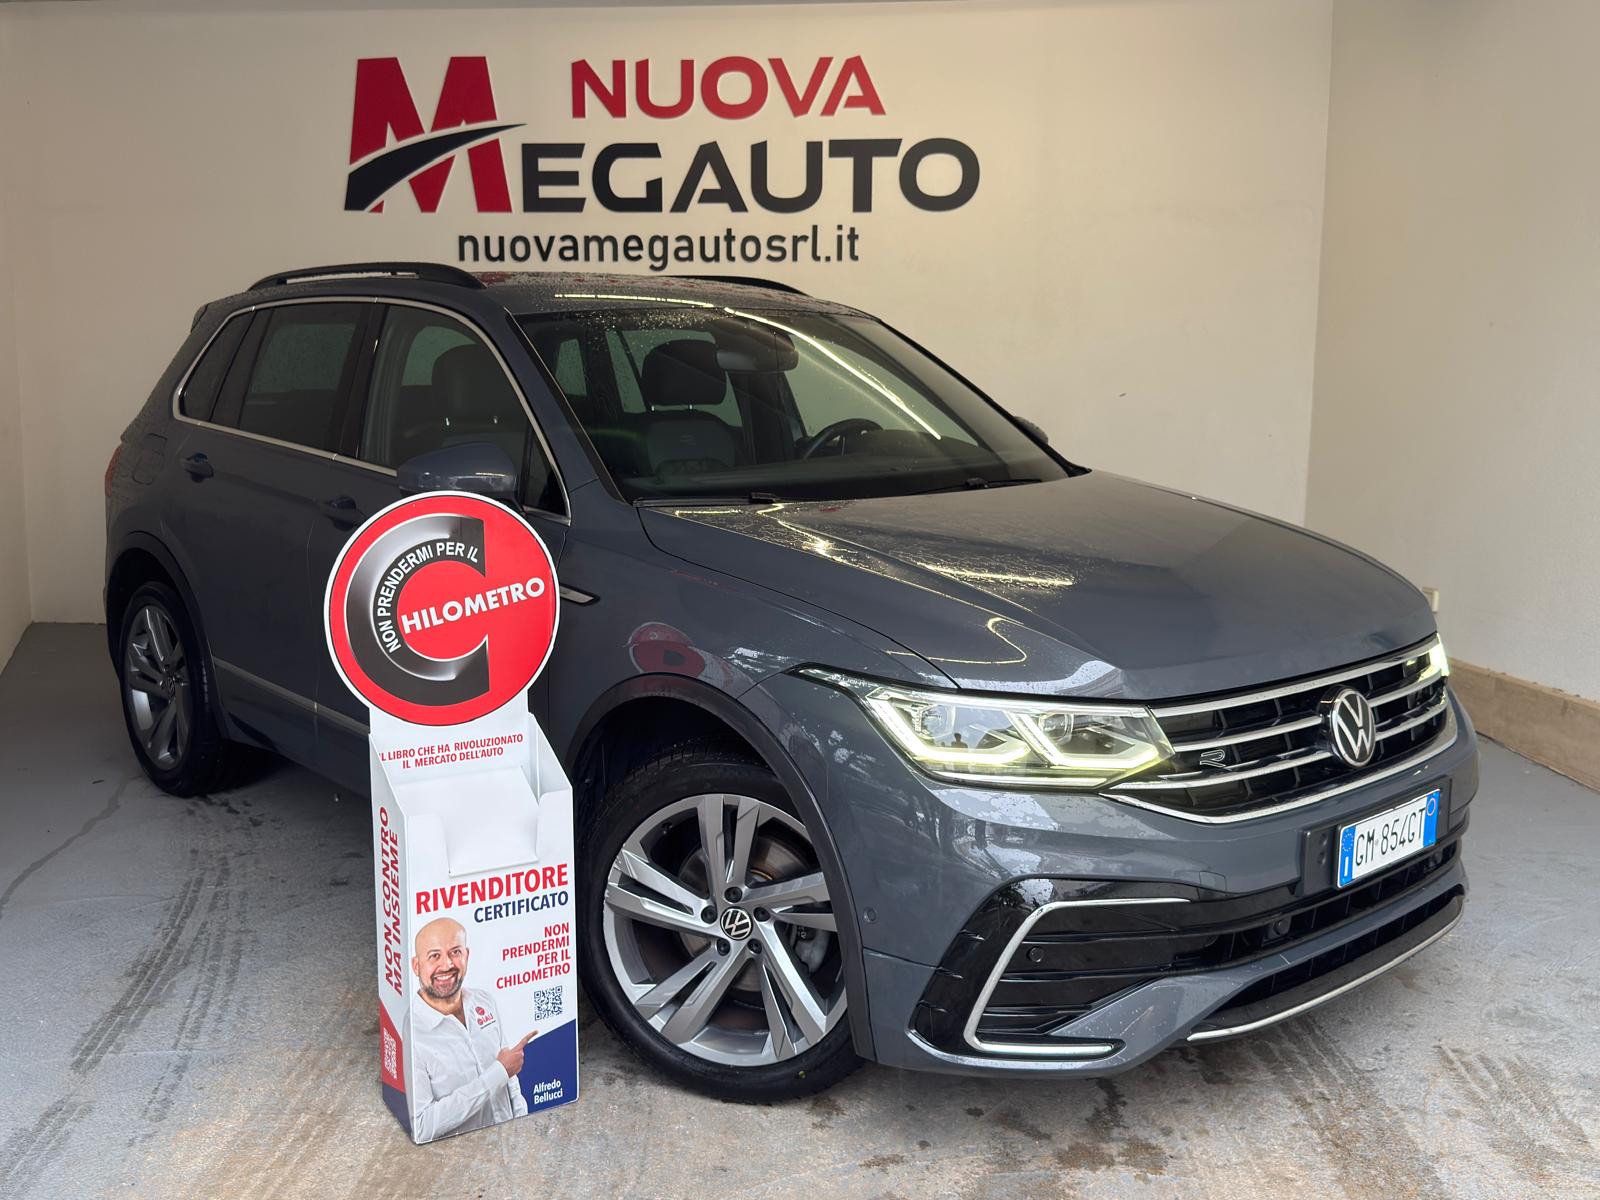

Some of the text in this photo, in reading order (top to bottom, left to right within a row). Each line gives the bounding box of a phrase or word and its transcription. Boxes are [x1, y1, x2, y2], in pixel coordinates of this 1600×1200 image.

[571, 55, 887, 119] NUOVA
[457, 225, 860, 271] nuovamegautosrl.it
[377, 541, 479, 653] NON PRENDERMI PER IL
[401, 577, 545, 634] HILOMETRO
[388, 748, 415, 761] LIBRO
[417, 745, 436, 756] CHE
[438, 743, 450, 754] HA
[454, 733, 524, 750] RIVOLUZIONATO
[402, 760, 411, 769] IL
[414, 753, 457, 767] MERCATO
[1355, 828, 1376, 866] GM
[379, 806, 396, 987] NON CONTRO
[415, 863, 568, 914] RIVENDITORE
[389, 829, 403, 996] MA INSIEME
[473, 890, 569, 923] CERTIFICATO
[544, 922, 570, 938] NON
[502, 936, 570, 961] PRENDERMI
[537, 949, 571, 967] PER IL
[496, 963, 571, 990] CHILOMETRO
[533, 1078, 562, 1095] Alfredo
[534, 1087, 563, 1105] Bellucci
